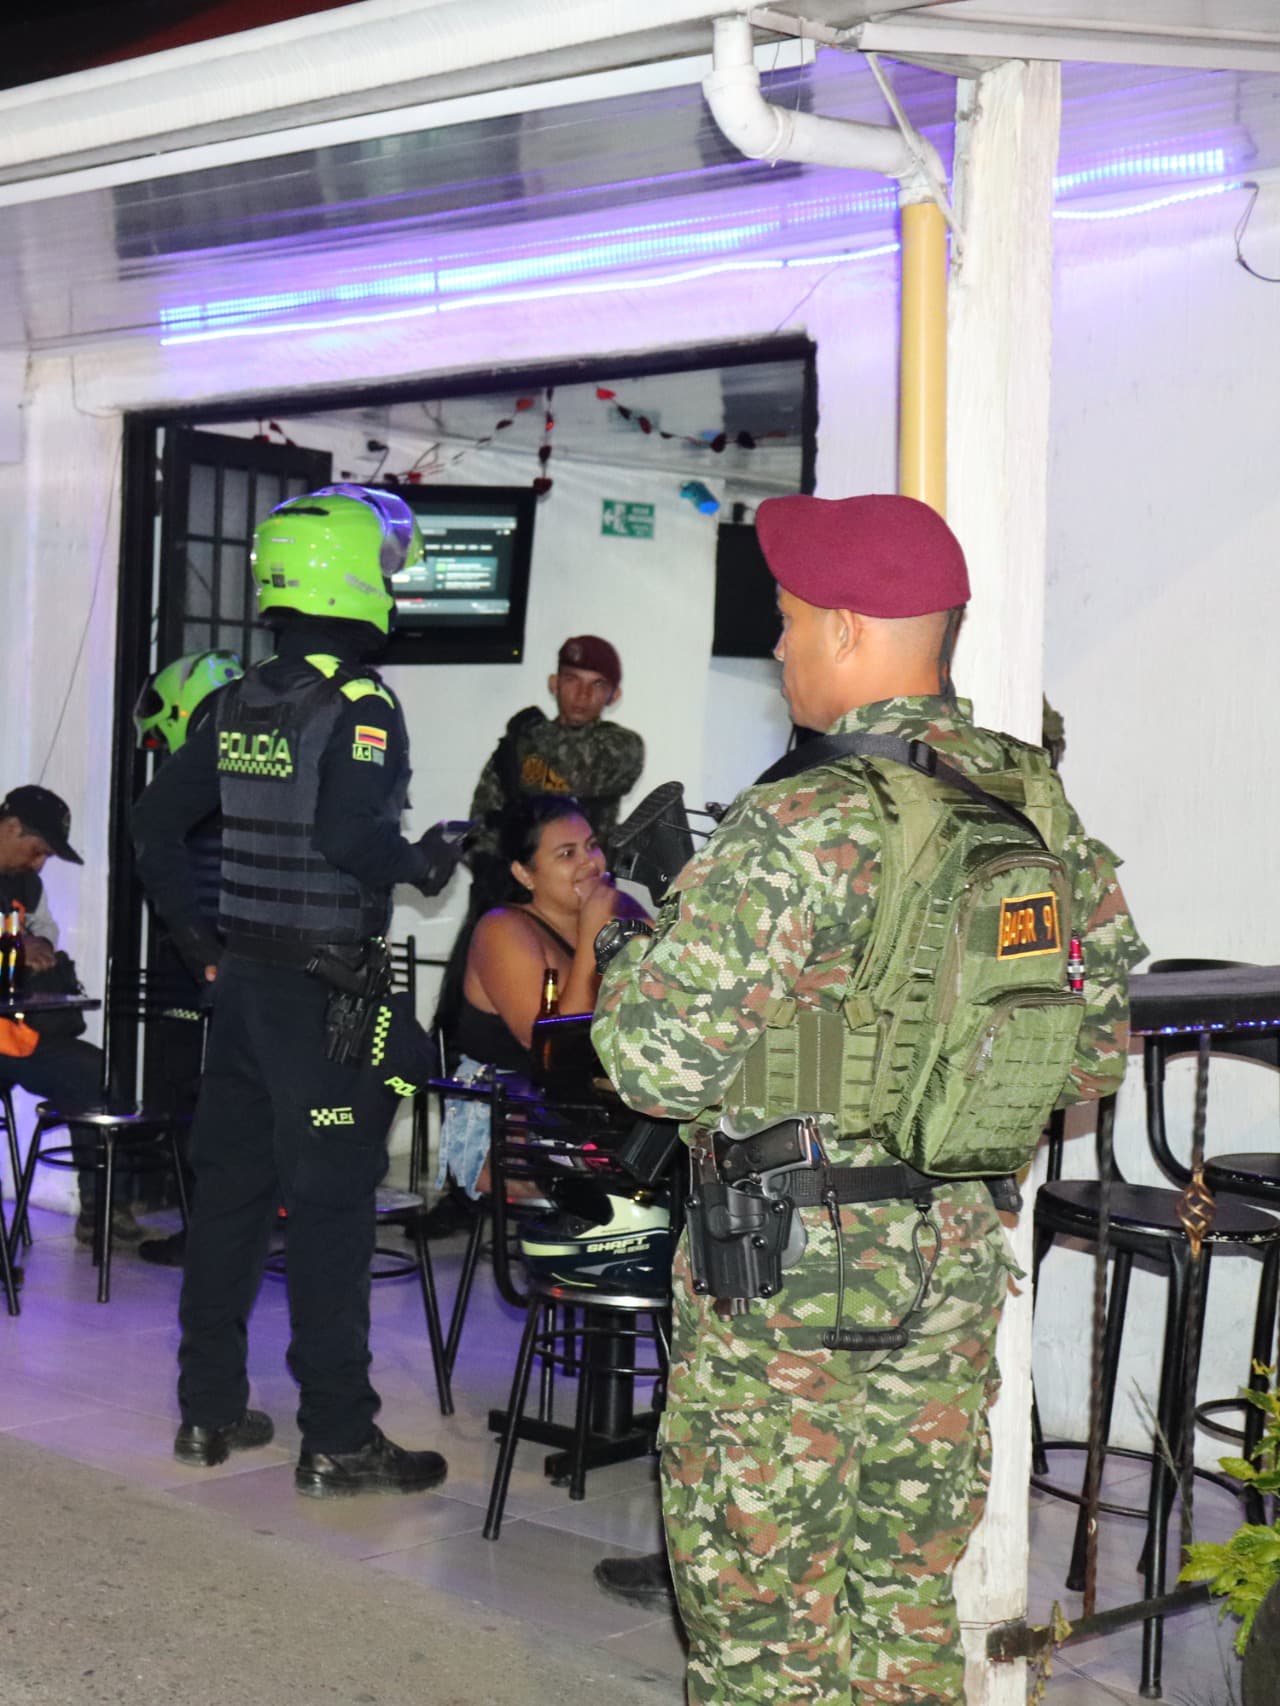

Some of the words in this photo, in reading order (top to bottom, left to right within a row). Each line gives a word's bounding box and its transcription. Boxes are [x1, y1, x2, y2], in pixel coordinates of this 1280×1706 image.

[219, 729, 292, 764] POLICÍA
[1042, 905, 1054, 941] 9
[586, 1236, 648, 1253] SHAFT
